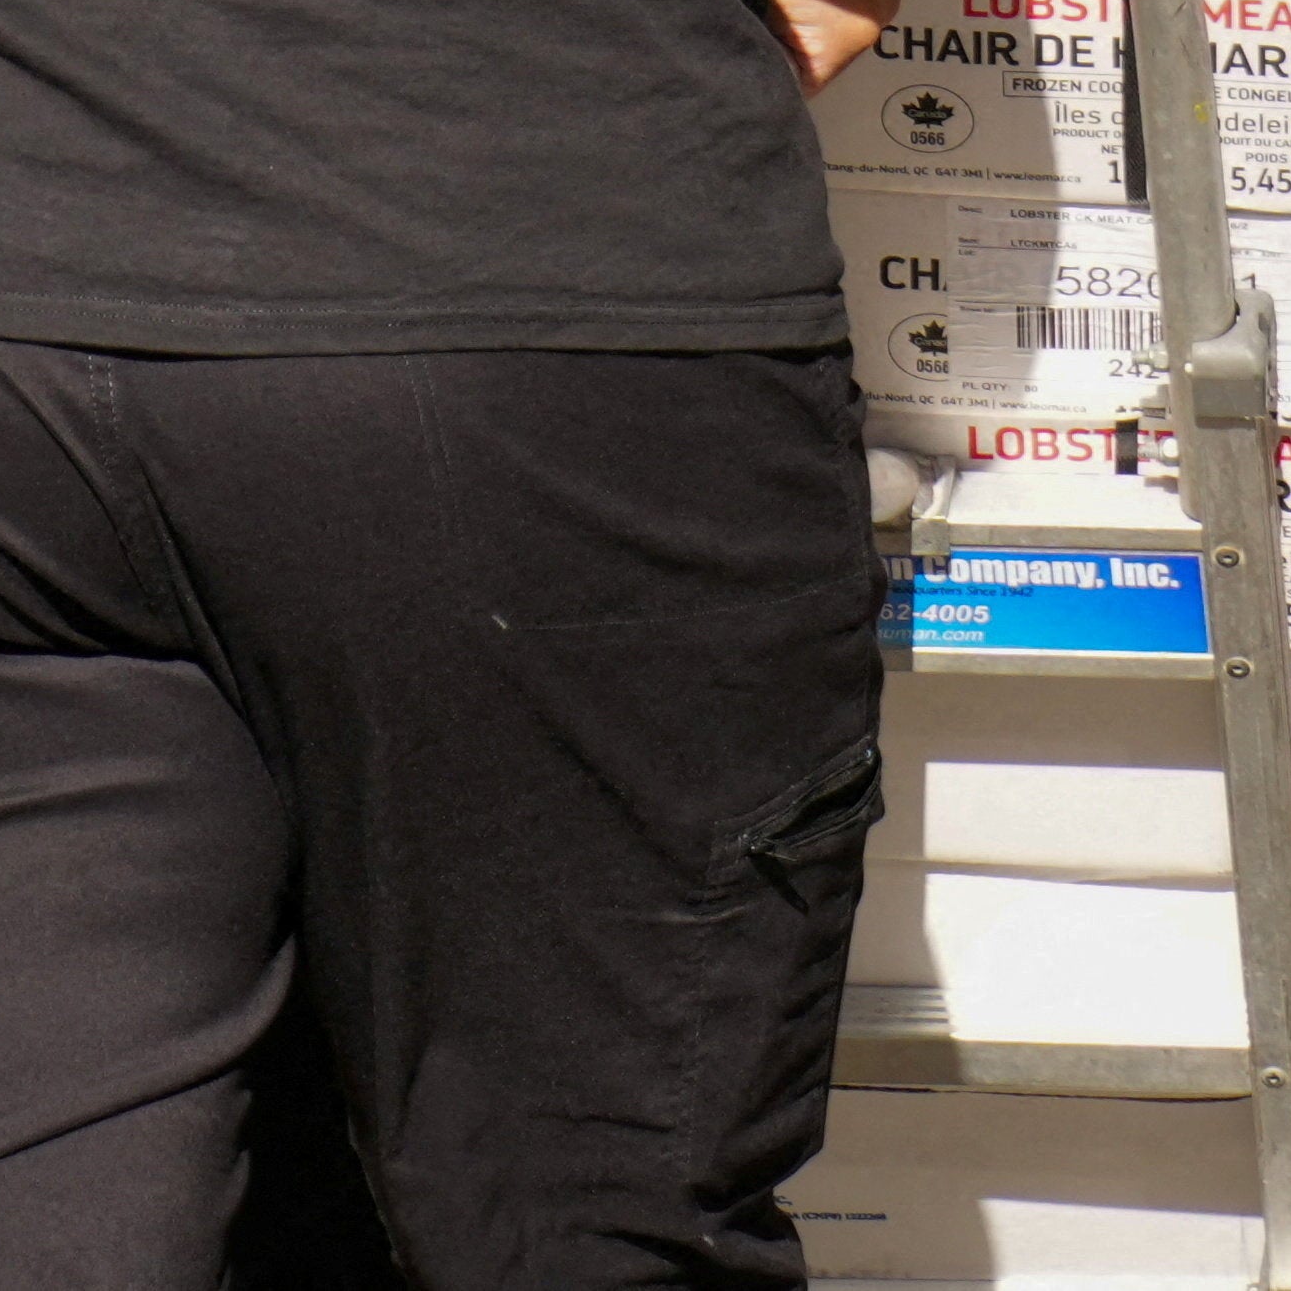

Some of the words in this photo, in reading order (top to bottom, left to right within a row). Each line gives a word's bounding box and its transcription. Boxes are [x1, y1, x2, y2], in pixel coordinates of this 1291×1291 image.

[873, 24, 1020, 67] CHAIR
[1034, 34, 1095, 69] DE
[1012, 77, 1083, 93] FROZEN
[1052, 127, 1109, 139] PRODUCT
[1255, 137, 1272, 147] DU
[1245, 152, 1288, 165] POIDS
[913, 166, 928, 176] QC
[1010, 209, 1071, 222] LOBSTER
[1097, 215, 1132, 225] MEAT
[919, 396, 935, 406] QC
[922, 556, 1106, 589] Company,
[1109, 557, 1181, 589] Inc.
[879, 602, 991, 624] 62-4005
